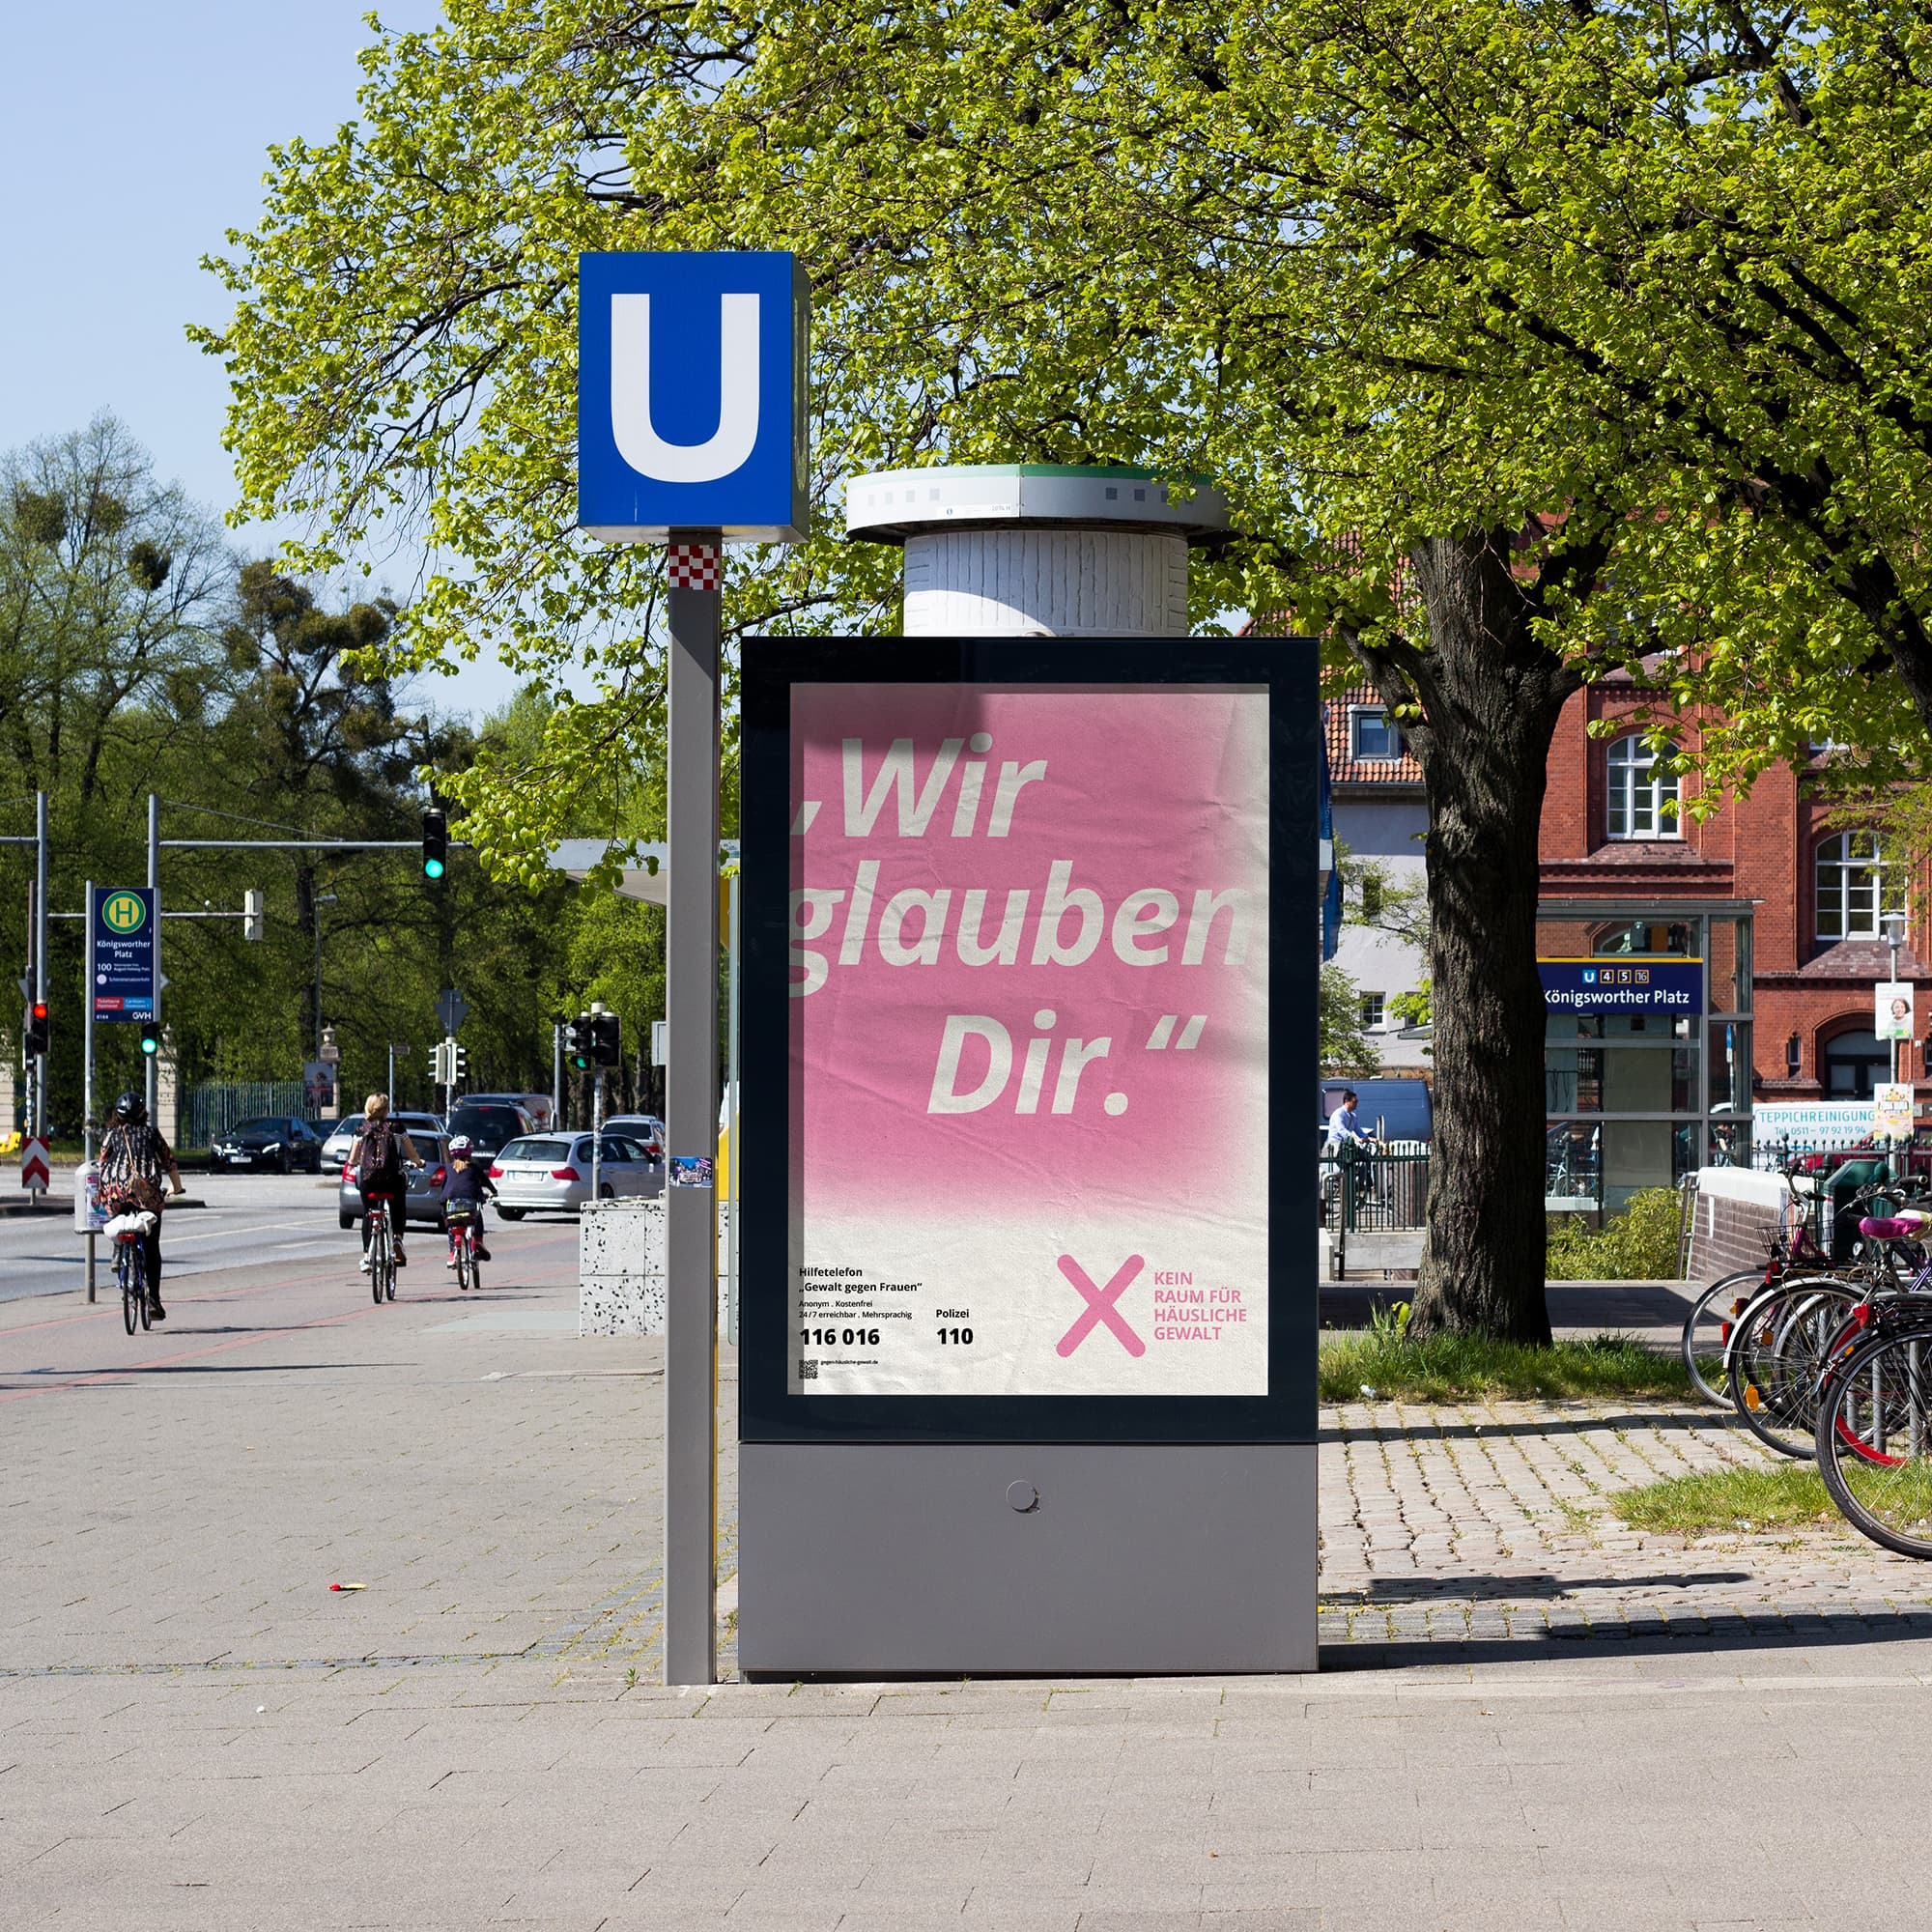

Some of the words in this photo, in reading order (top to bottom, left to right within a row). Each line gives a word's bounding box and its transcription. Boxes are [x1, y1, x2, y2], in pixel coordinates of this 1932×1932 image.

[611, 294, 759, 482] U
[788, 860, 1249, 998] glauben
[97, 940, 151, 950] Königsworther
[1584, 972, 1595, 982] U
[1604, 972, 1610, 980] 4
[1621, 972, 1628, 980] 5
[1637, 972, 1647, 980] 16
[1654, 989, 1690, 1004] Platz
[799, 1267, 863, 1277] Hilfetelefon
[1154, 1271, 1193, 1285] KEIN
[844, 1285, 877, 1294] gegen
[1154, 1291, 1204, 1303] RAUM
[1210, 1287, 1241, 1303] FÜR
[798, 1300, 830, 1309] Anonym
[862, 1311, 913, 1320] Mehrsprachig
[936, 1309, 970, 1318] Polizei
[1154, 1306, 1247, 1321] HÄUSLICHE
[800, 1329, 837, 1345] 116
[842, 1329, 880, 1345] 016
[937, 1328, 974, 1345] 110
[1154, 1327, 1222, 1340] GEWALT
